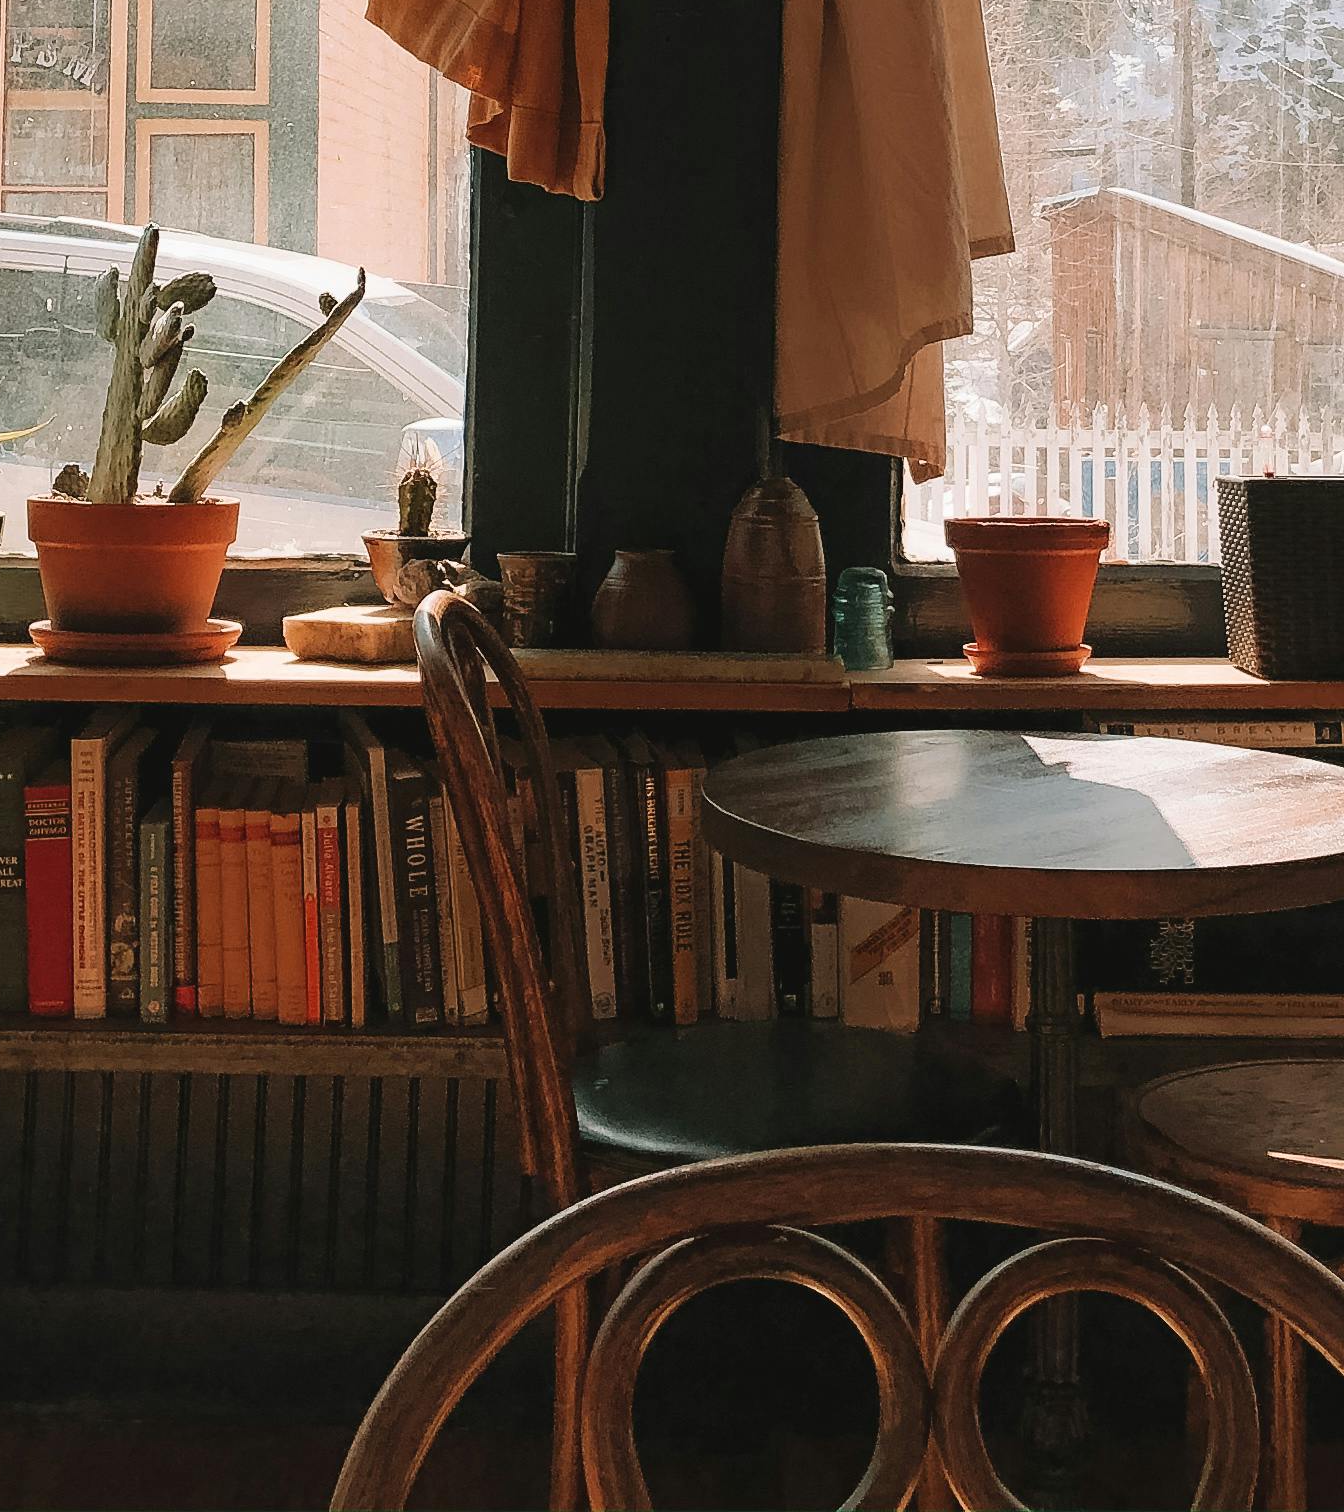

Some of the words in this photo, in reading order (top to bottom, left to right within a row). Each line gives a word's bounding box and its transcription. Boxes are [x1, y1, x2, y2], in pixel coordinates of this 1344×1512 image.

[1146, 727, 1201, 737] LAST
[1217, 725, 1303, 735] BREATH
[645, 776, 656, 798] HIS
[29, 818, 67, 827] DOCTOR
[593, 798, 604, 825] THE
[646, 799, 658, 843] BRIGHT
[29, 826, 68, 836] ZHIVAGO
[321, 831, 333, 861] Julia
[404, 814, 429, 899] WHOLE
[648, 843, 660, 881] LIGHT
[674, 839, 691, 871] THE
[322, 864, 335, 904] Alvarez
[587, 879, 599, 910] MAN
[676, 913, 693, 953] RULE
